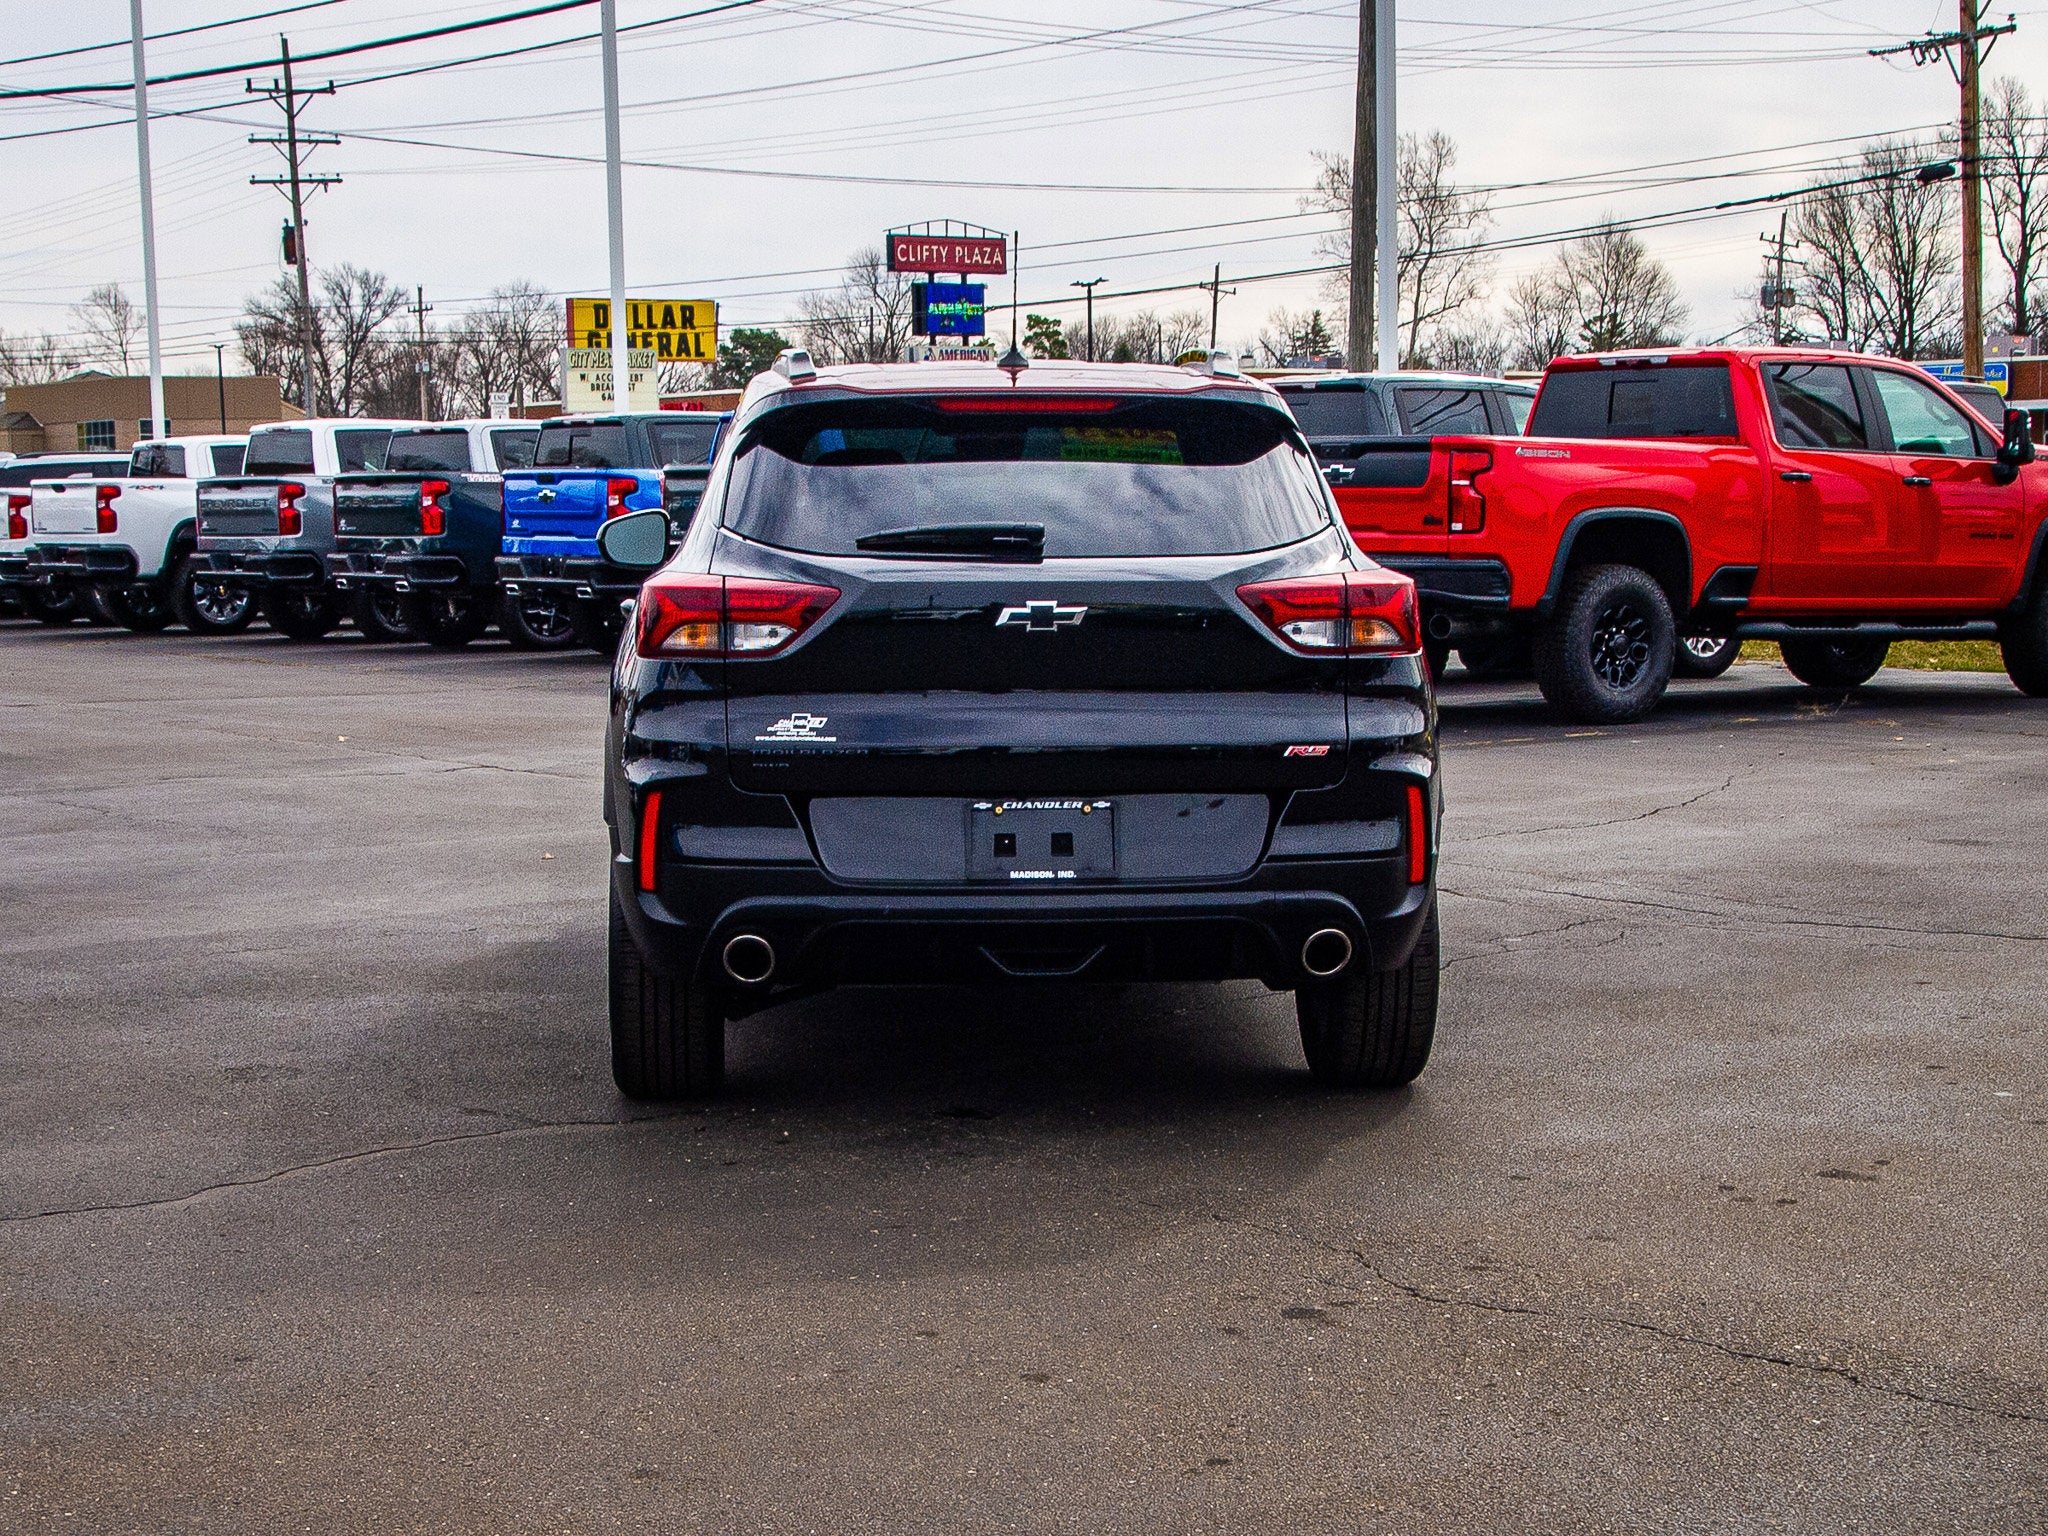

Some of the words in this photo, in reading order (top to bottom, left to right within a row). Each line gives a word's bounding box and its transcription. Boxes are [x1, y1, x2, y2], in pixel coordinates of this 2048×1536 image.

[897, 244, 948, 262] CLIFTY
[955, 246, 1003, 265] PLAZA
[593, 303, 696, 330] DLLAR
[587, 331, 706, 358] GERAL
[590, 350, 614, 368] MEA
[627, 350, 655, 368] ARKET
[938, 348, 990, 361] AMERICAN
[1283, 745, 1330, 757] RS
[1002, 801, 1083, 809] CHANDLER
[1057, 870, 1077, 879] IND.
